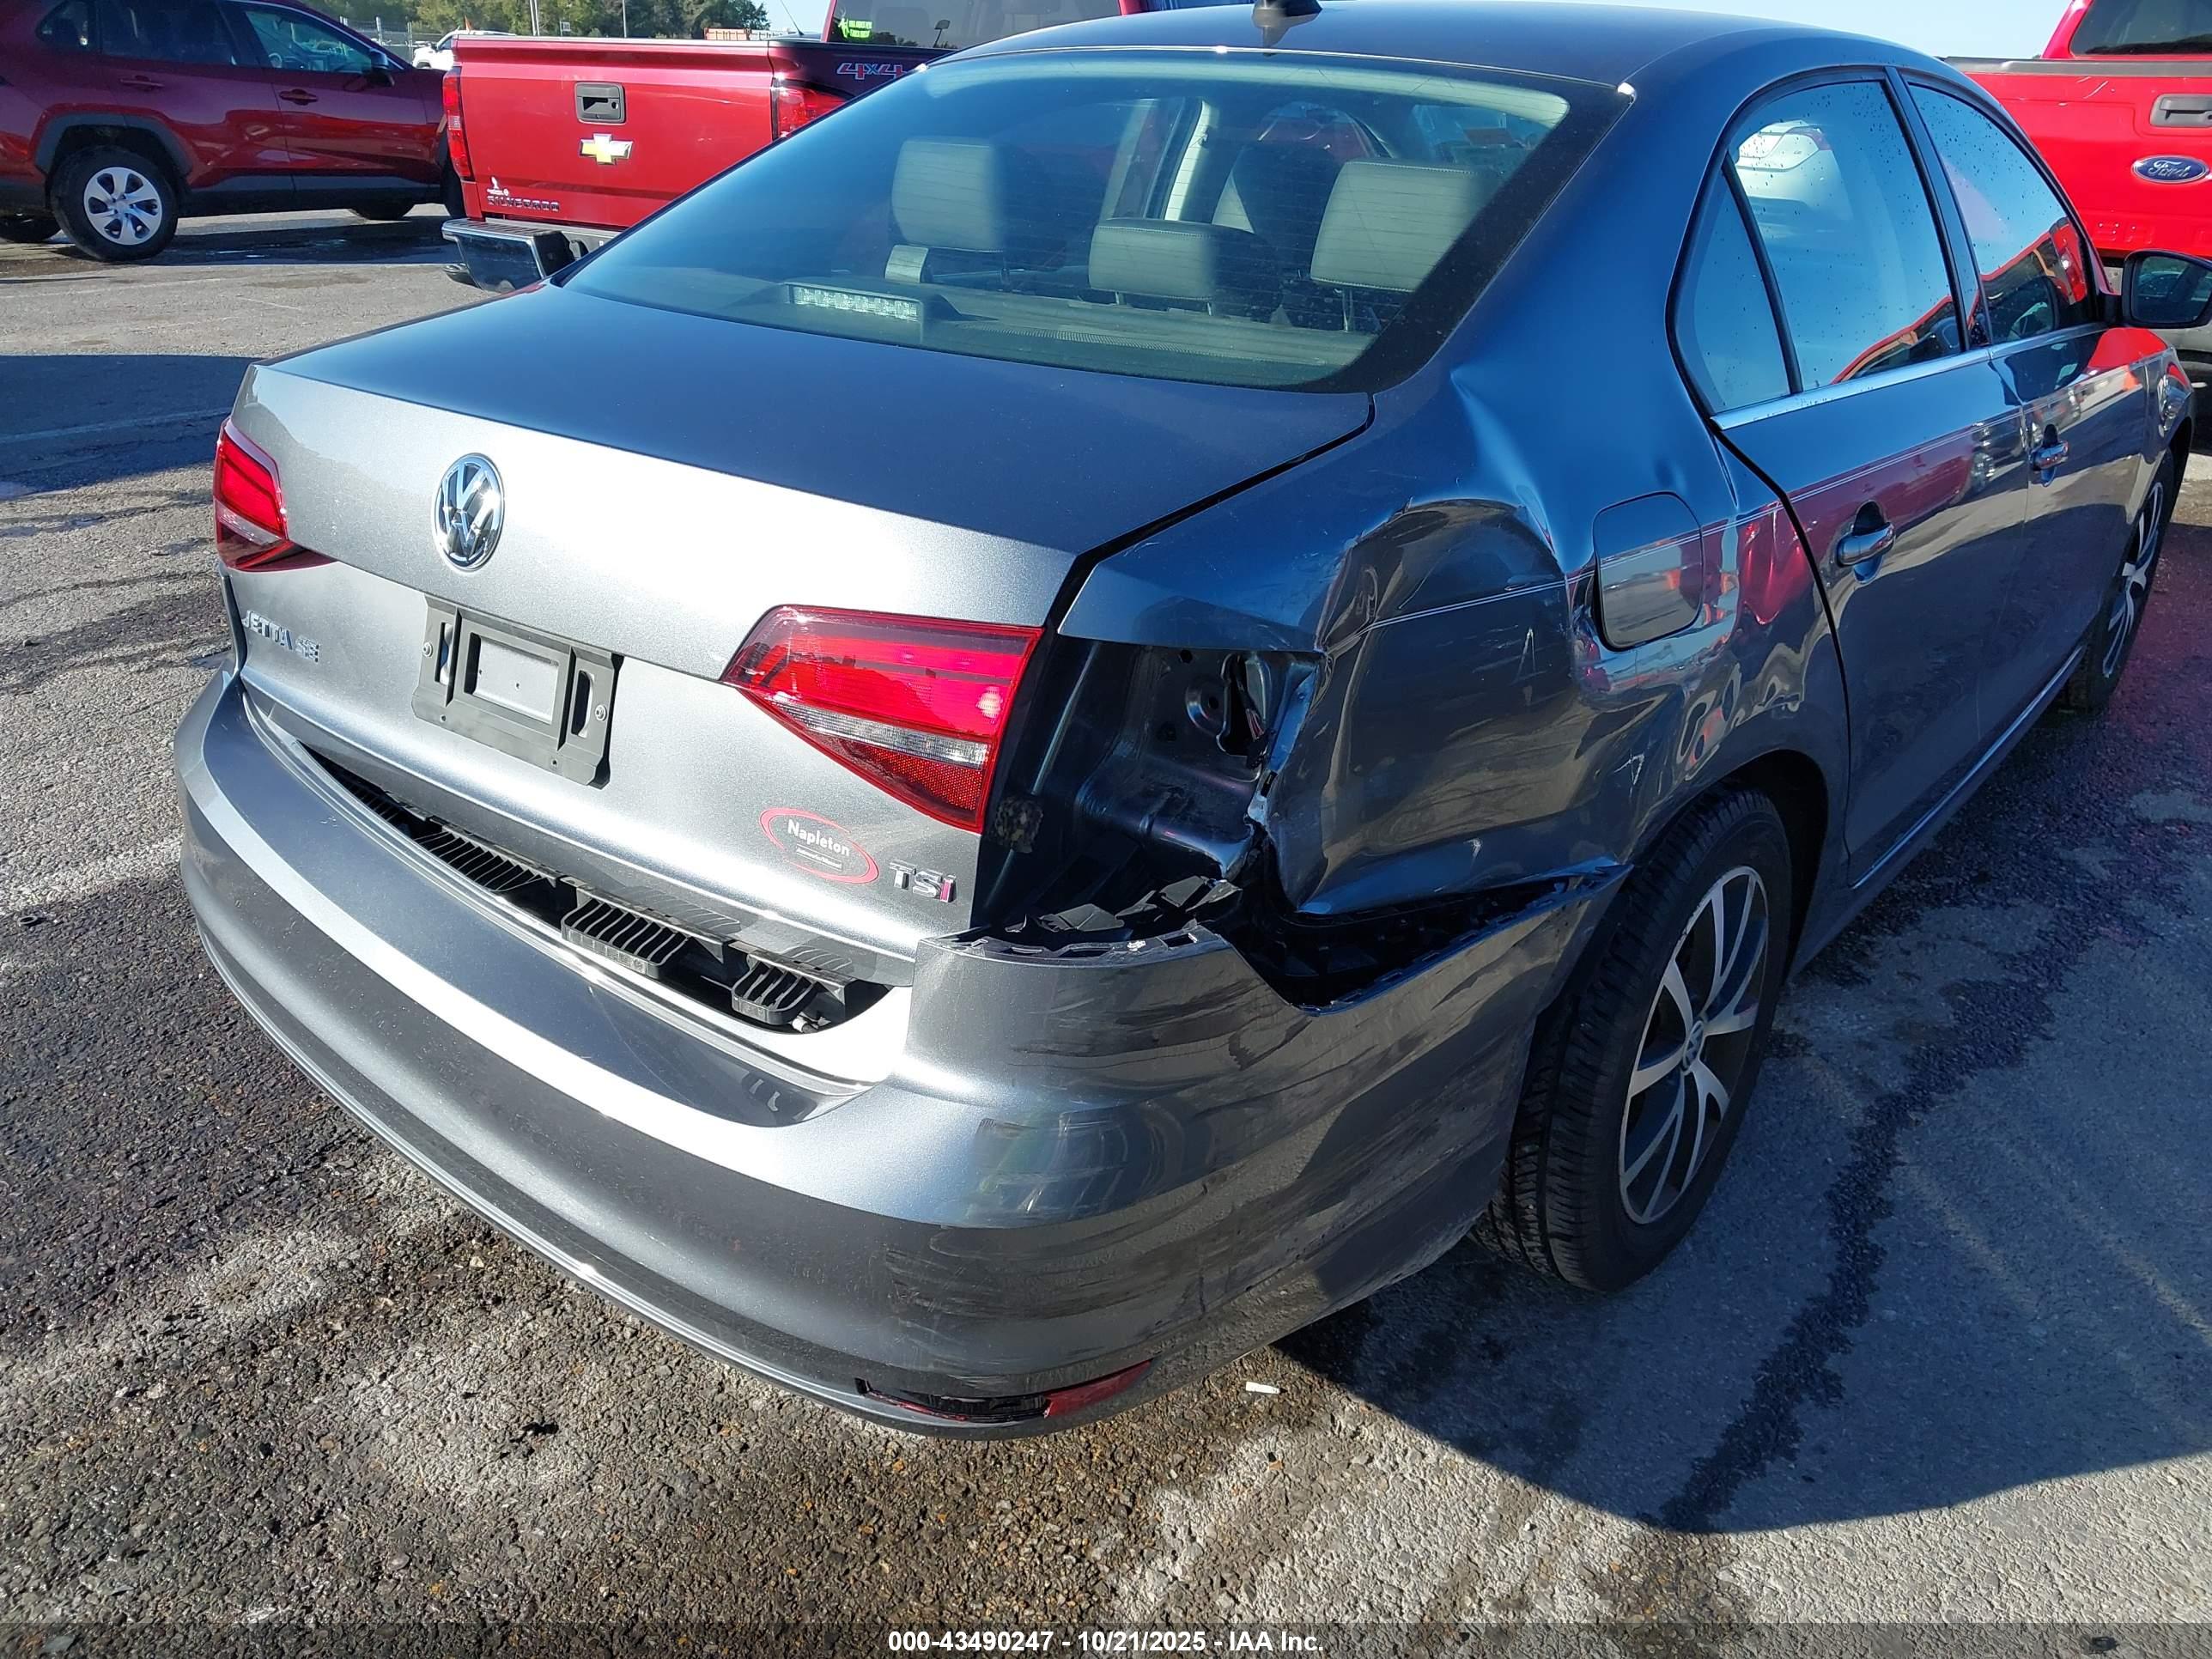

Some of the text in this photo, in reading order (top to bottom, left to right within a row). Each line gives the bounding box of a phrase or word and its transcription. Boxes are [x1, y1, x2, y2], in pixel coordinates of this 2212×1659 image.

[2148, 160, 2191, 178] Ford
[240, 610, 294, 651] JETTA
[787, 818, 850, 857] Napleton
